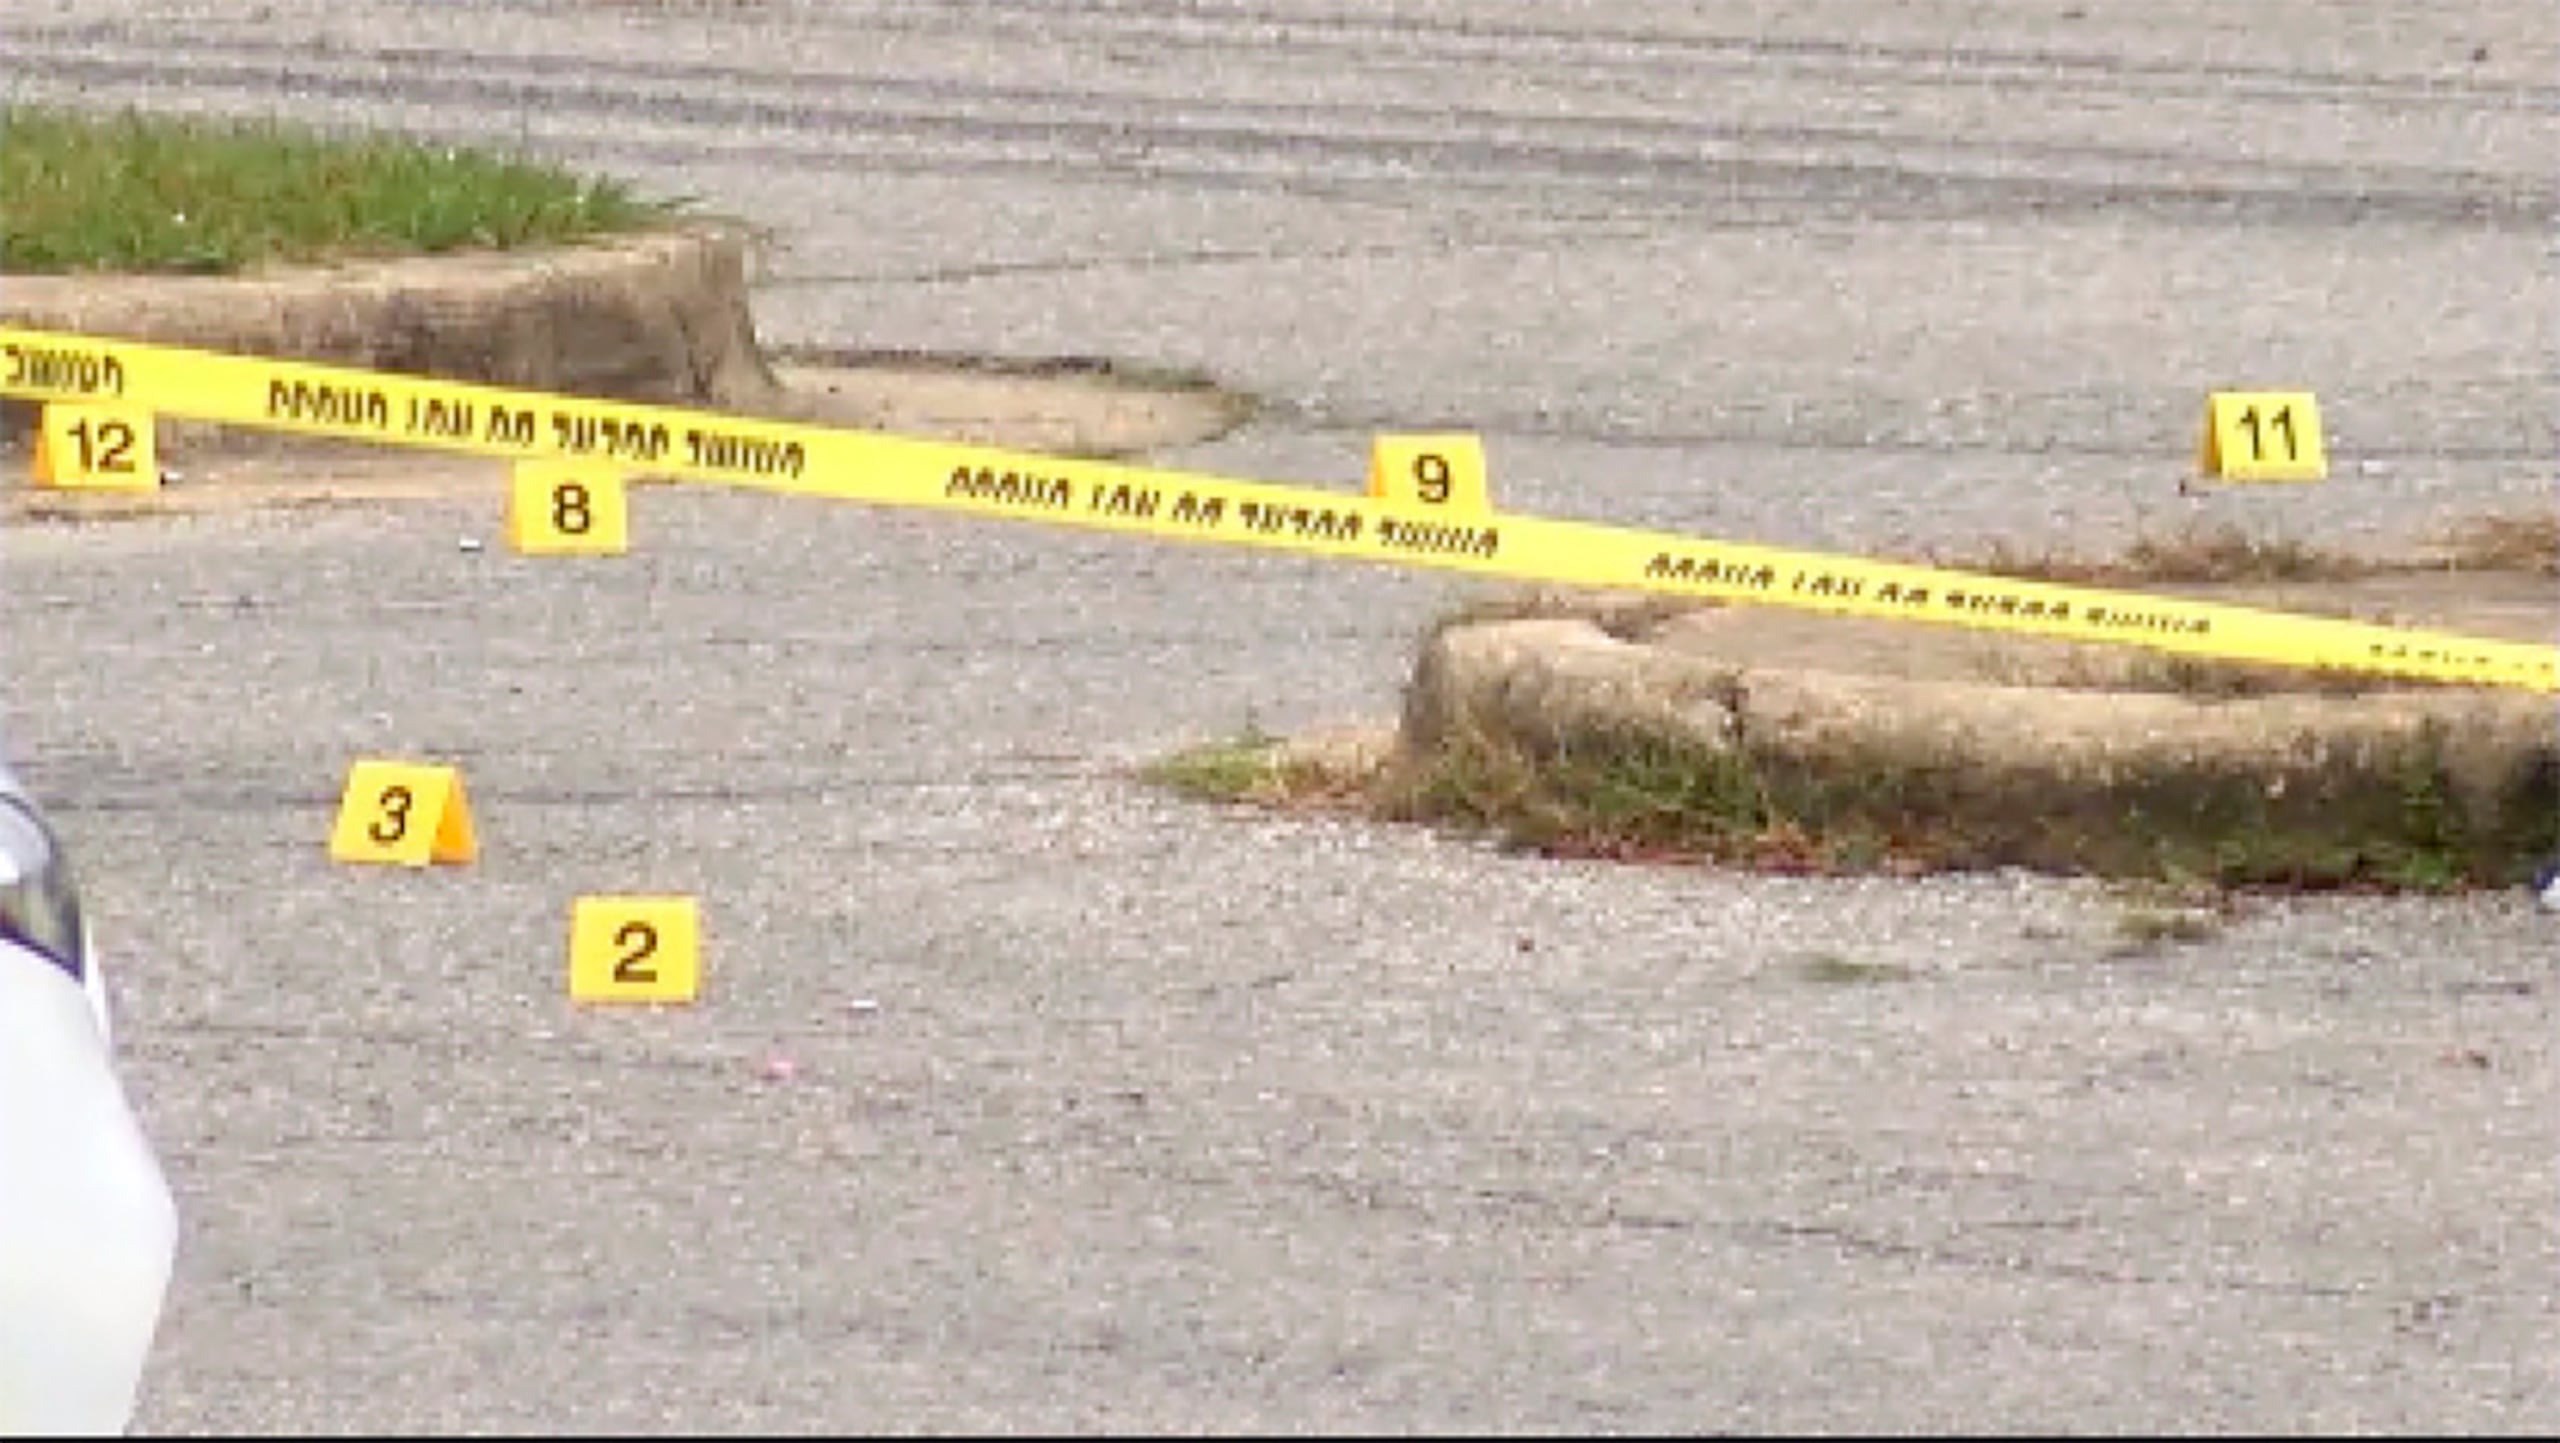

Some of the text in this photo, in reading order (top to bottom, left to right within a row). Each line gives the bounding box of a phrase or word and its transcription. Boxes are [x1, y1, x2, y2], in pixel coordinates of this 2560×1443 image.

[67, 418, 136, 473] 12
[2237, 404, 2296, 460] 11
[1412, 454, 1450, 503] 9
[553, 484, 589, 533] 8
[368, 785, 412, 845] 3
[613, 920, 657, 983] 2
